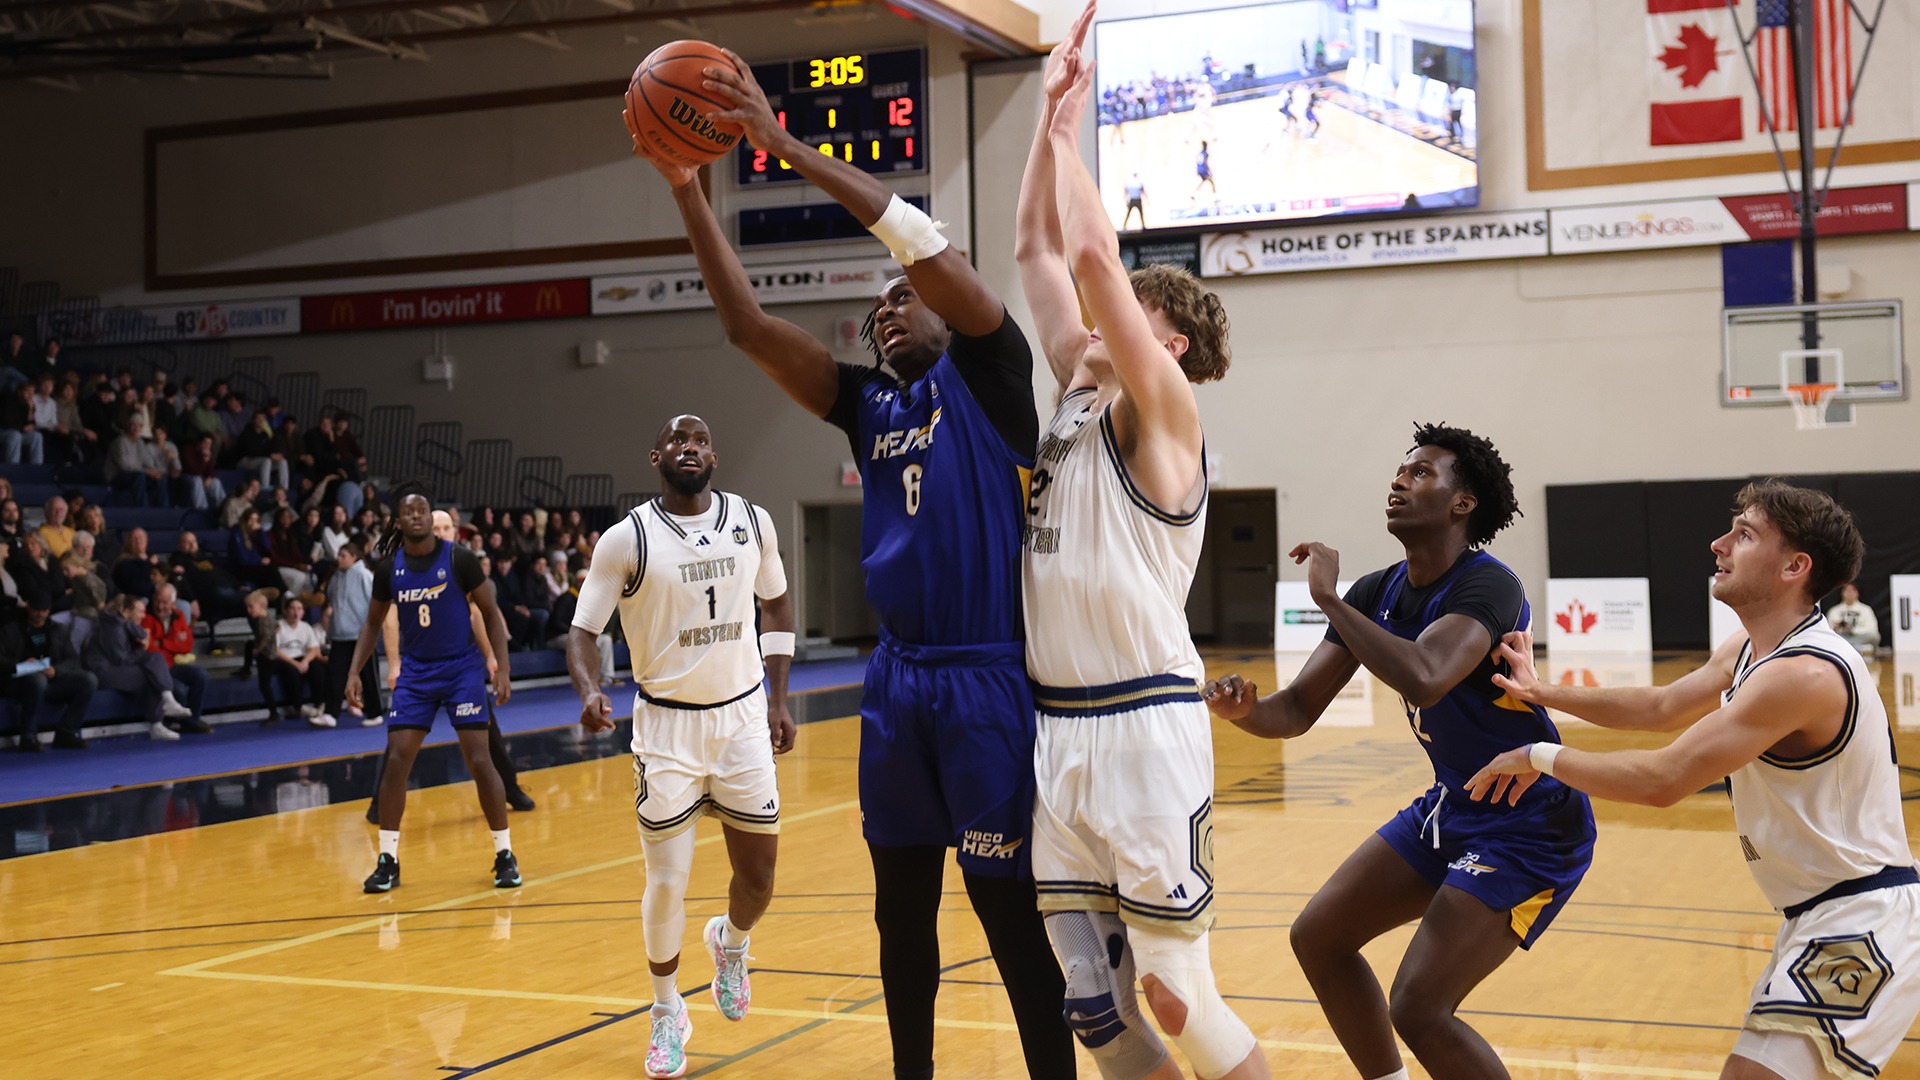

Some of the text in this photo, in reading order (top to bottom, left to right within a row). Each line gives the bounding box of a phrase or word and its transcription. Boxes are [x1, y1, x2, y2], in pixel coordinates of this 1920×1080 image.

[809, 55, 865, 88] 3:05
[669, 96, 736, 147] Wilson
[827, 108, 837, 129] 1
[888, 96, 914, 127] 12
[904, 136, 914, 158] 1
[1261, 219, 1546, 254] HOME OF THE SPARTANS
[829, 271, 873, 285] GMC
[229, 307, 287, 329] COUNTRY
[383, 290, 503, 321] i'm lovin' it
[871, 413, 940, 460] HEAT
[902, 463, 923, 516] 6
[1028, 468, 1053, 518] 2
[678, 556, 736, 583] TRINITY
[398, 584, 446, 603] HEAT
[705, 585, 716, 619] 1
[418, 603, 431, 627] 8
[678, 621, 743, 647] WESTERN
[962, 838, 1020, 860] HEAT
[964, 829, 1003, 844] UBCO
